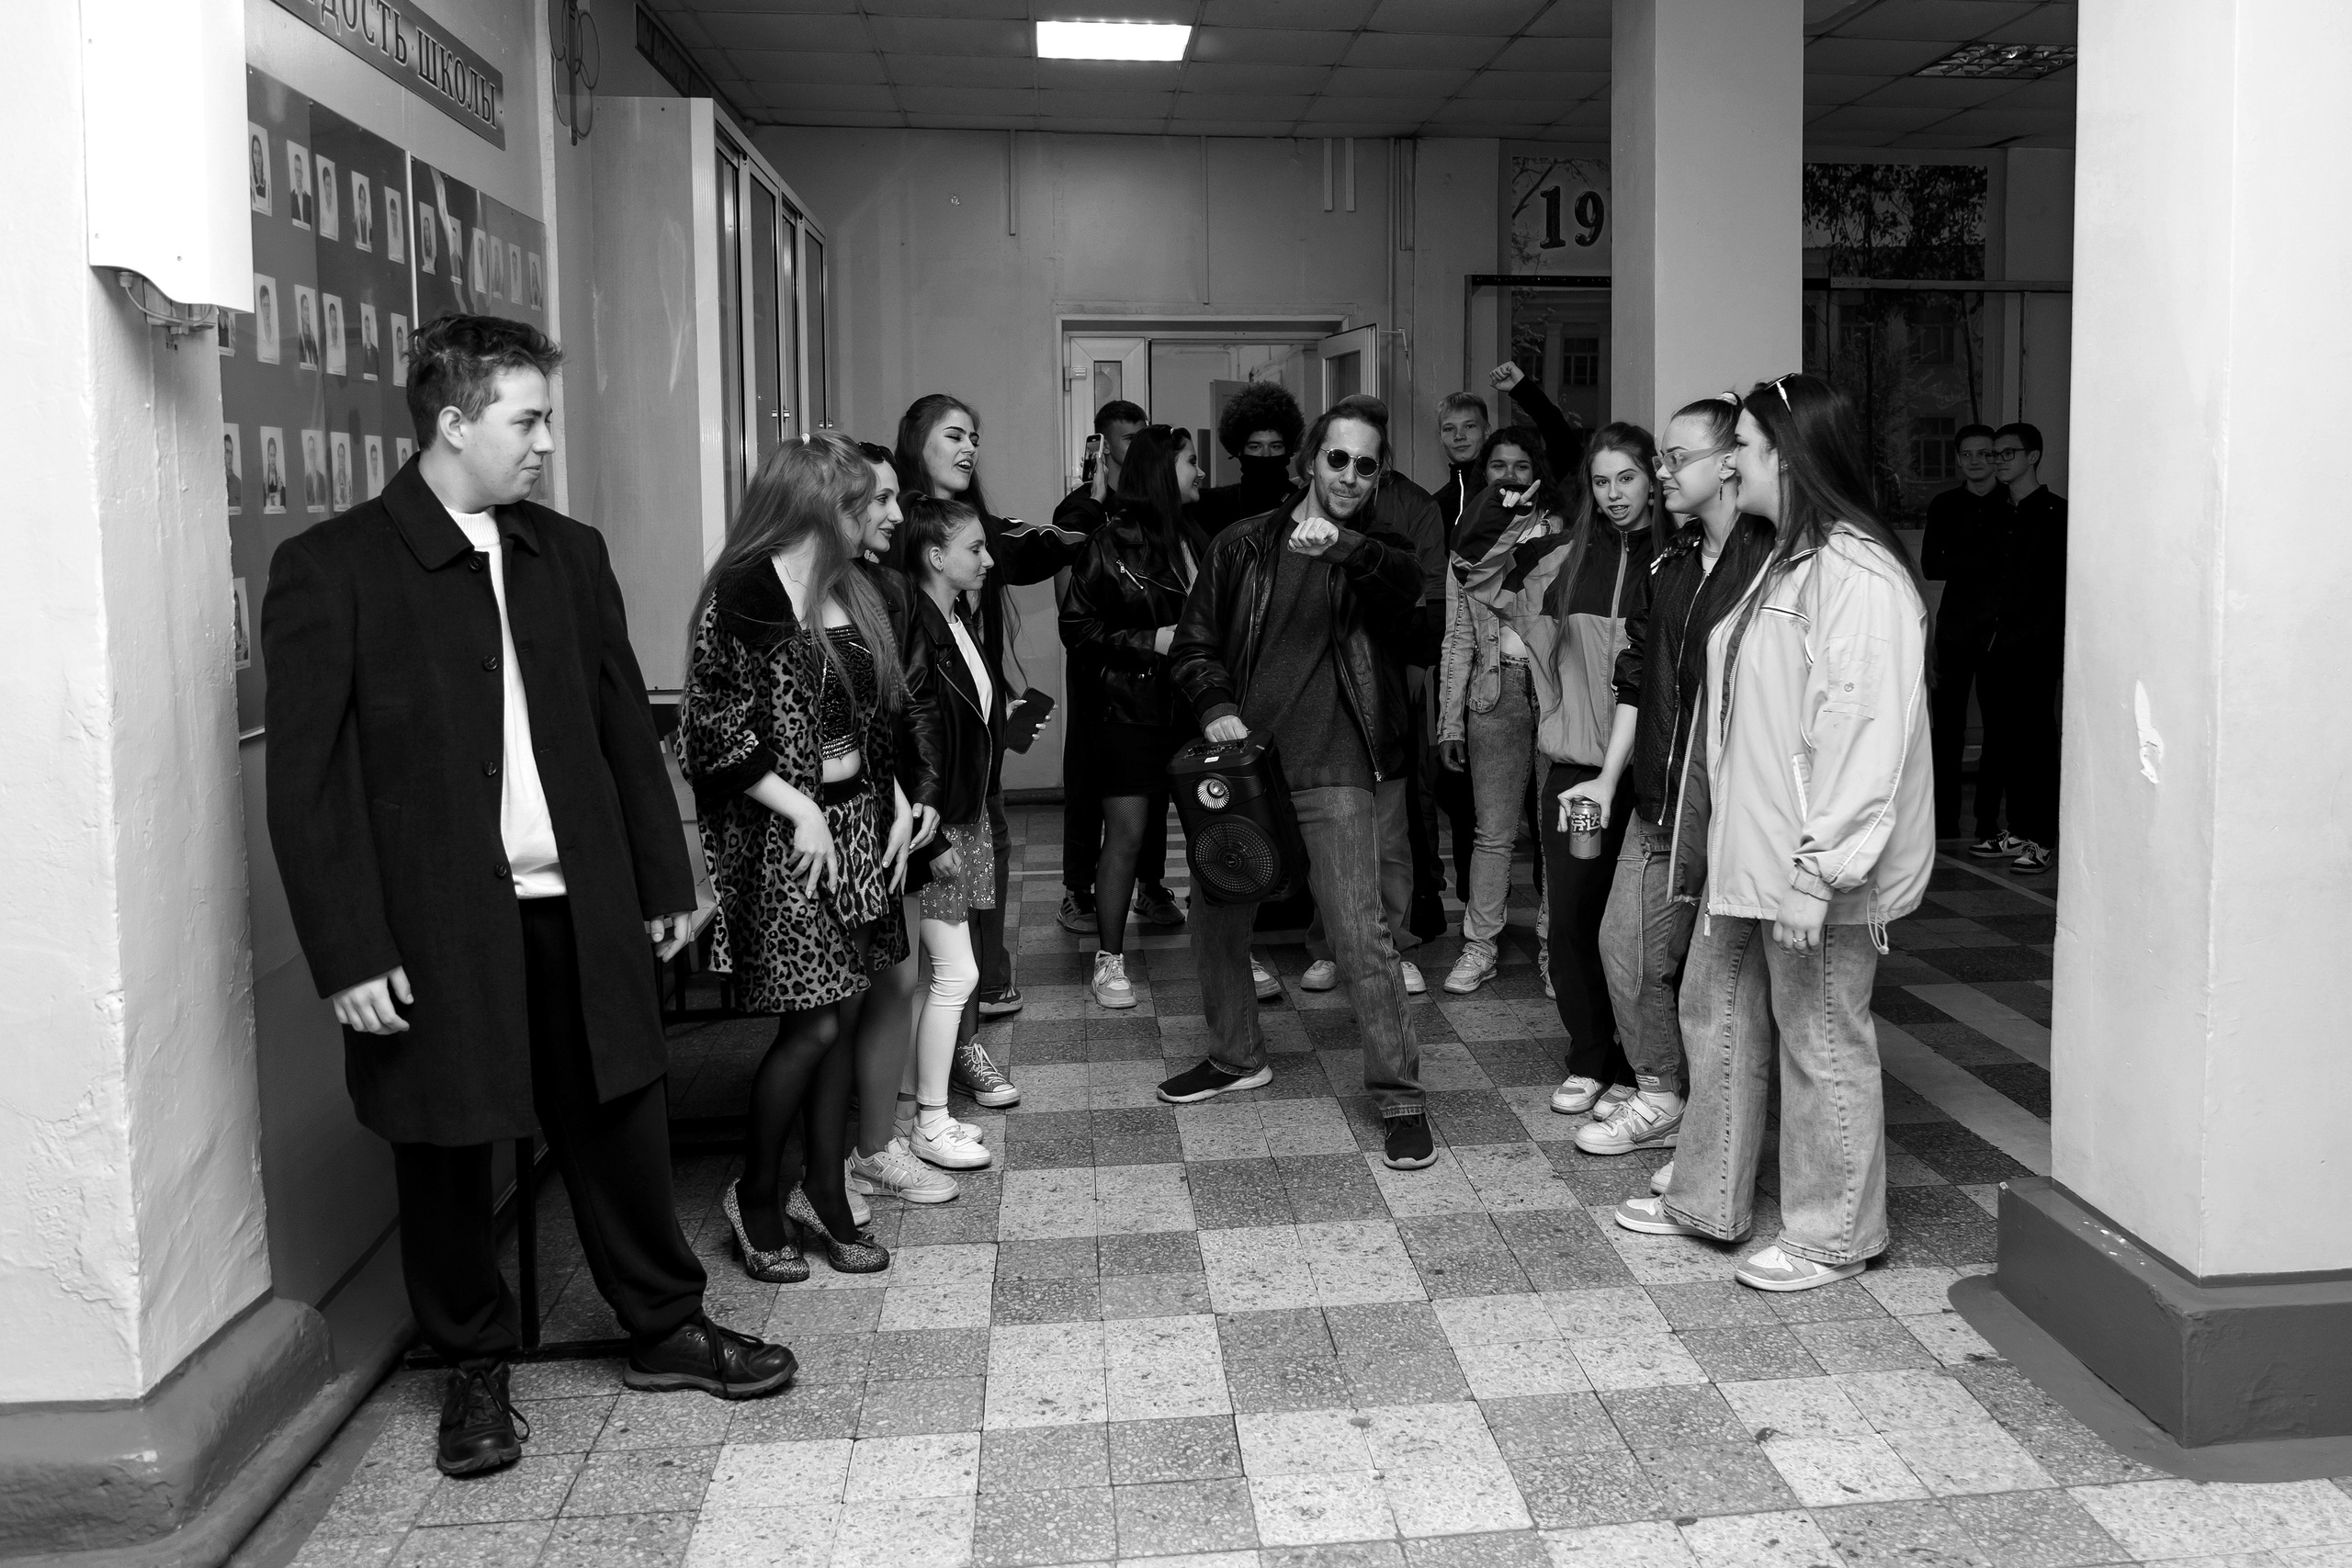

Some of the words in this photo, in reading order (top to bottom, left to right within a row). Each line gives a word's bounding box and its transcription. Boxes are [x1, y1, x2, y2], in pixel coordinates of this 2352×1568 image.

[307, 0, 407, 66] ДОСТЬ
[416, 26, 496, 130] ШКОЛЫ
[1540, 186, 1611, 249] 19
